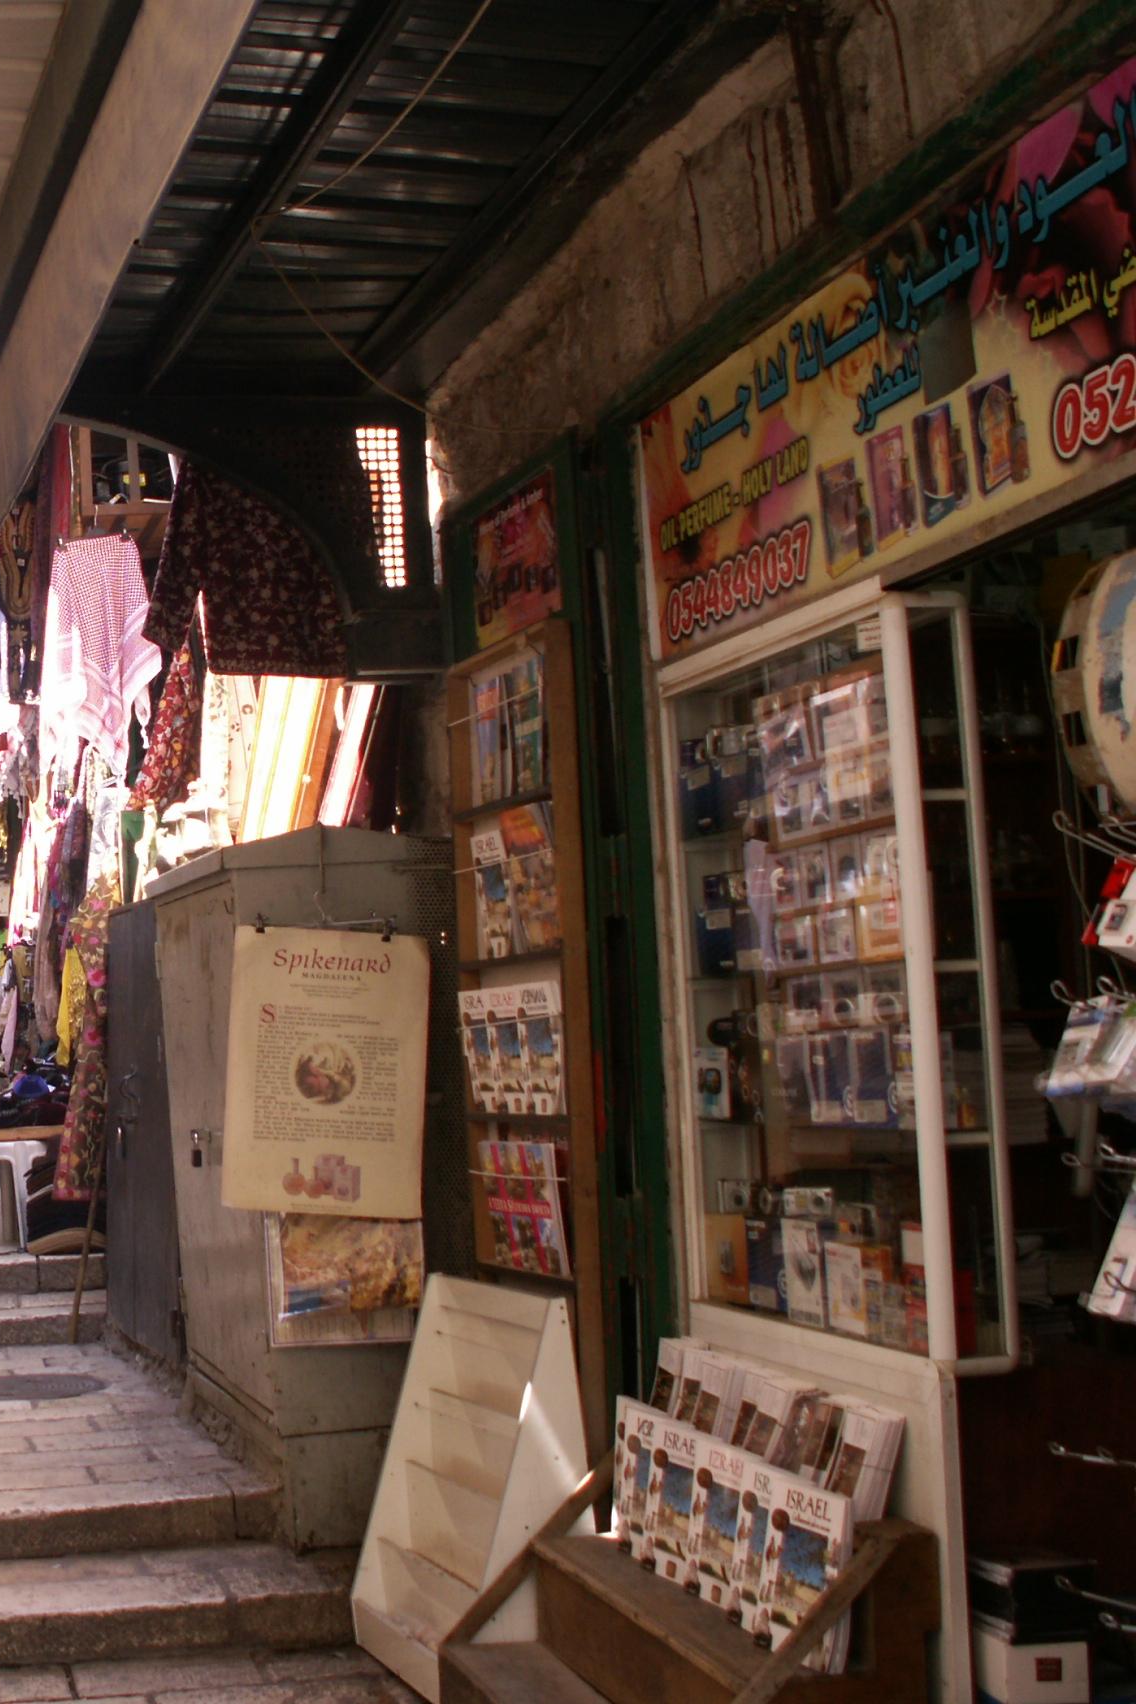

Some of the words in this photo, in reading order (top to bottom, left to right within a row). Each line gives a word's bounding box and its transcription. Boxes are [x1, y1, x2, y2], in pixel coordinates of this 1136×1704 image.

[1025, 267, 1098, 338] المقدسة
[754, 341, 789, 412] لها
[661, 517, 679, 551] OIL
[678, 481, 731, 542] PERFUME
[741, 455, 772, 507] HOLY
[775, 435, 809, 486] LAND
[667, 518, 811, 640] 0544849037
[785, 1487, 831, 1522] ISRAEL
